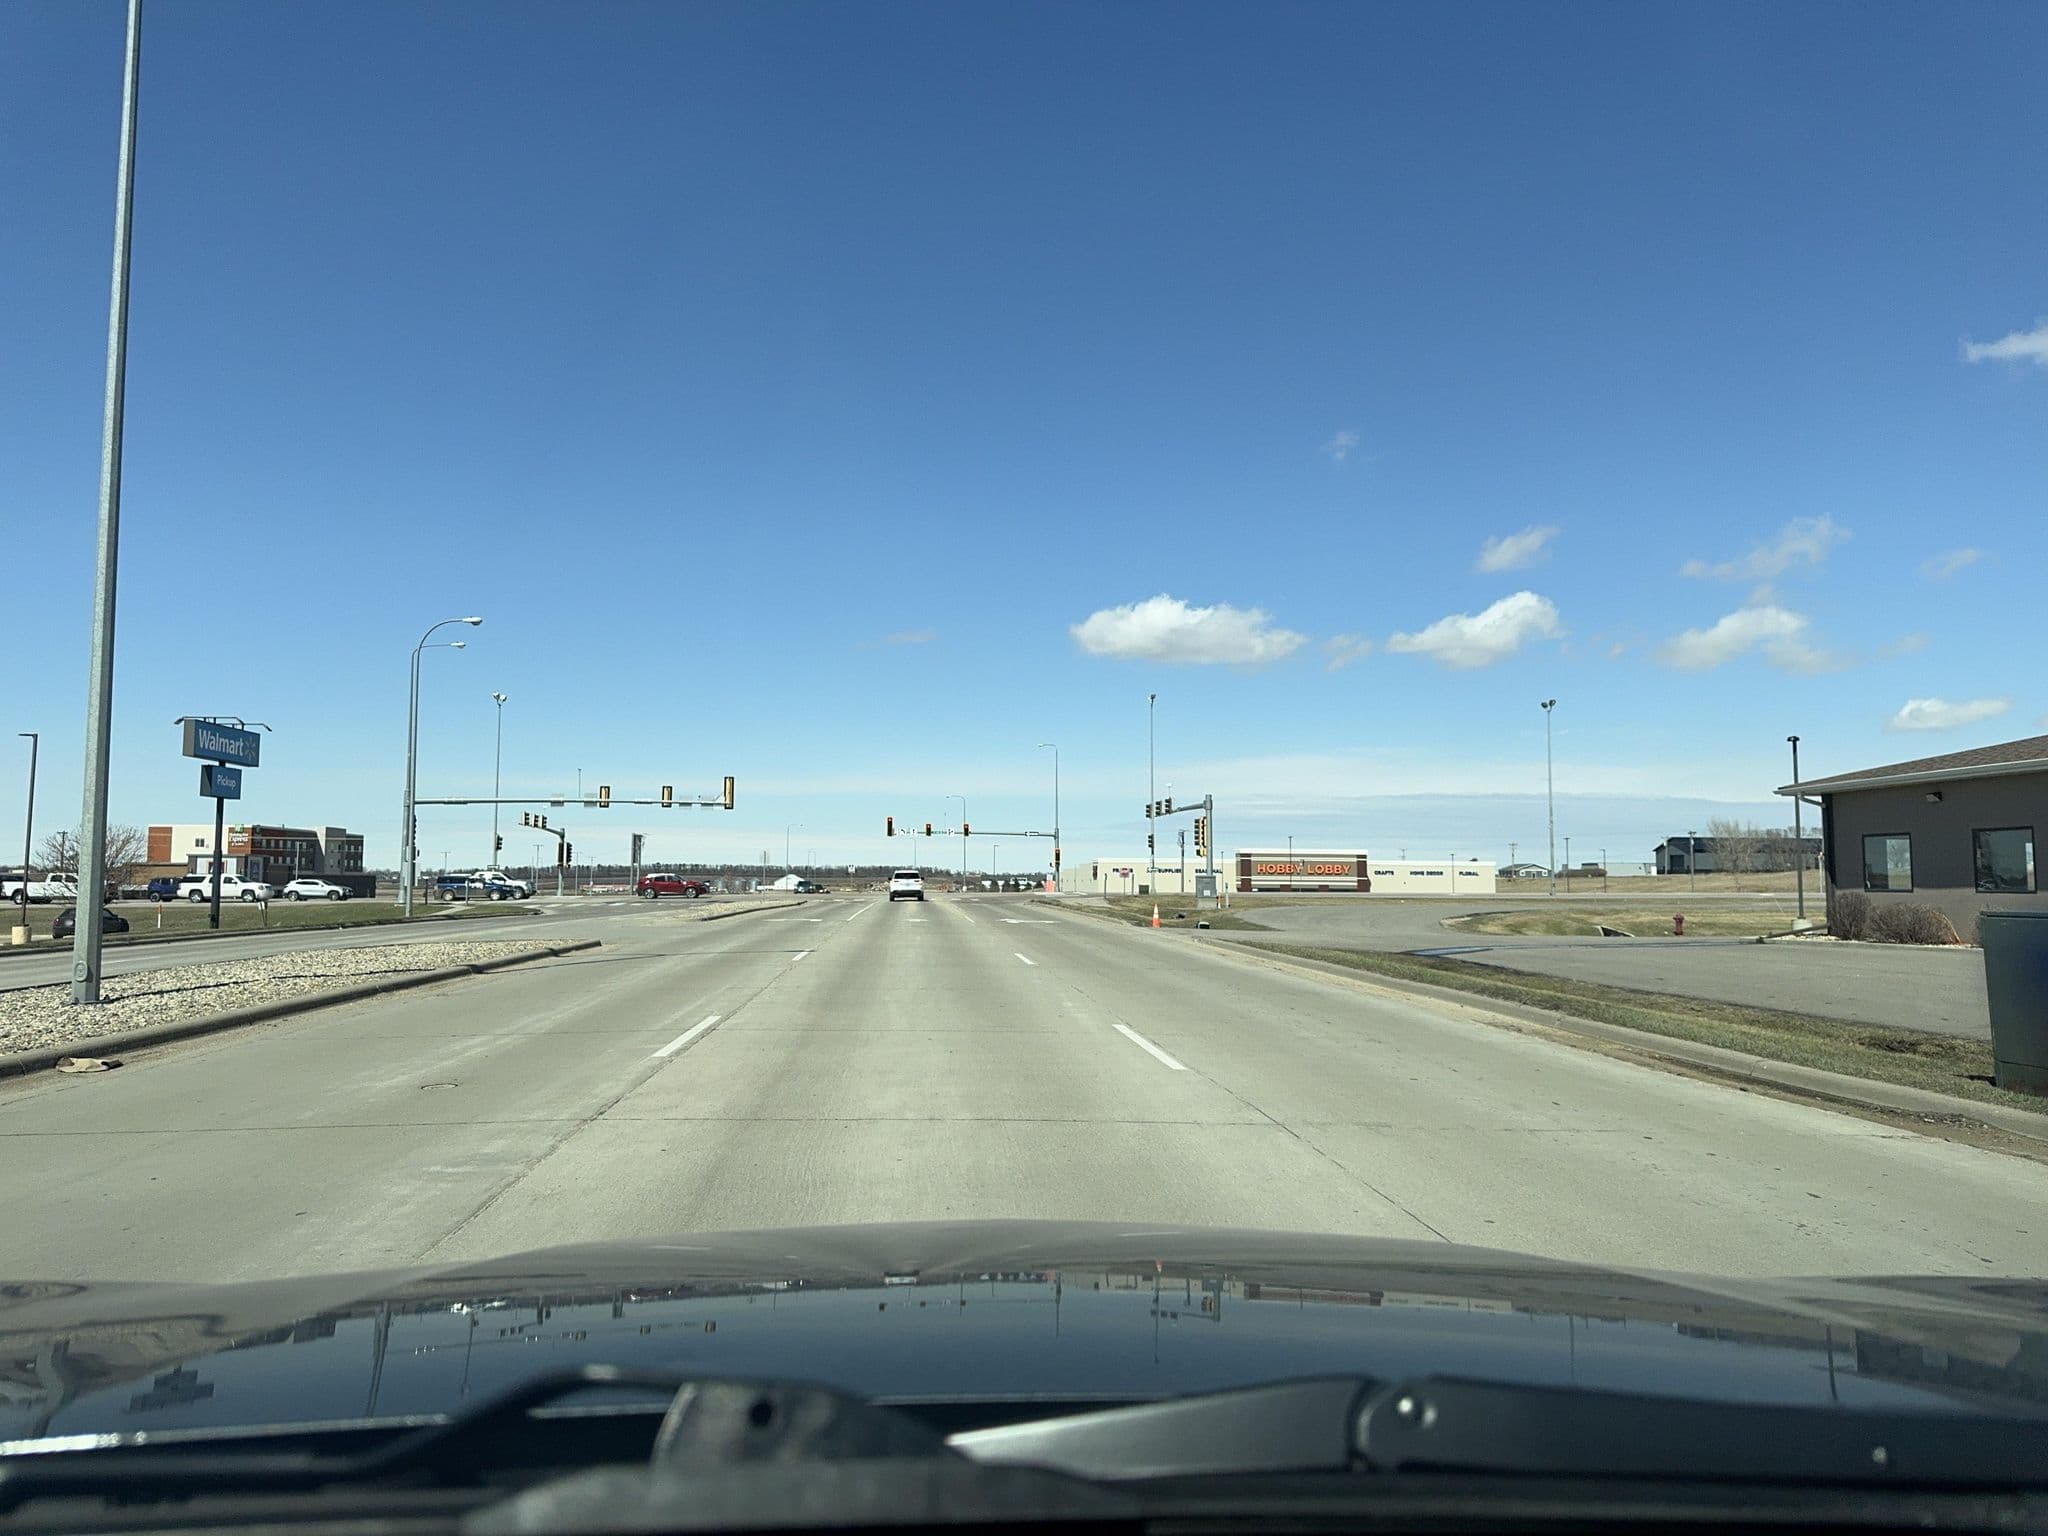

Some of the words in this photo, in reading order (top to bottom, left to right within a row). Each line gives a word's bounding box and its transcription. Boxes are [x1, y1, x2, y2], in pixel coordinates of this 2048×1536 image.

[199, 728, 243, 756] Walmart
[217, 774, 237, 790] Pickup
[1257, 863, 1303, 875] HOBBY
[1307, 864, 1352, 876] LOBBY
